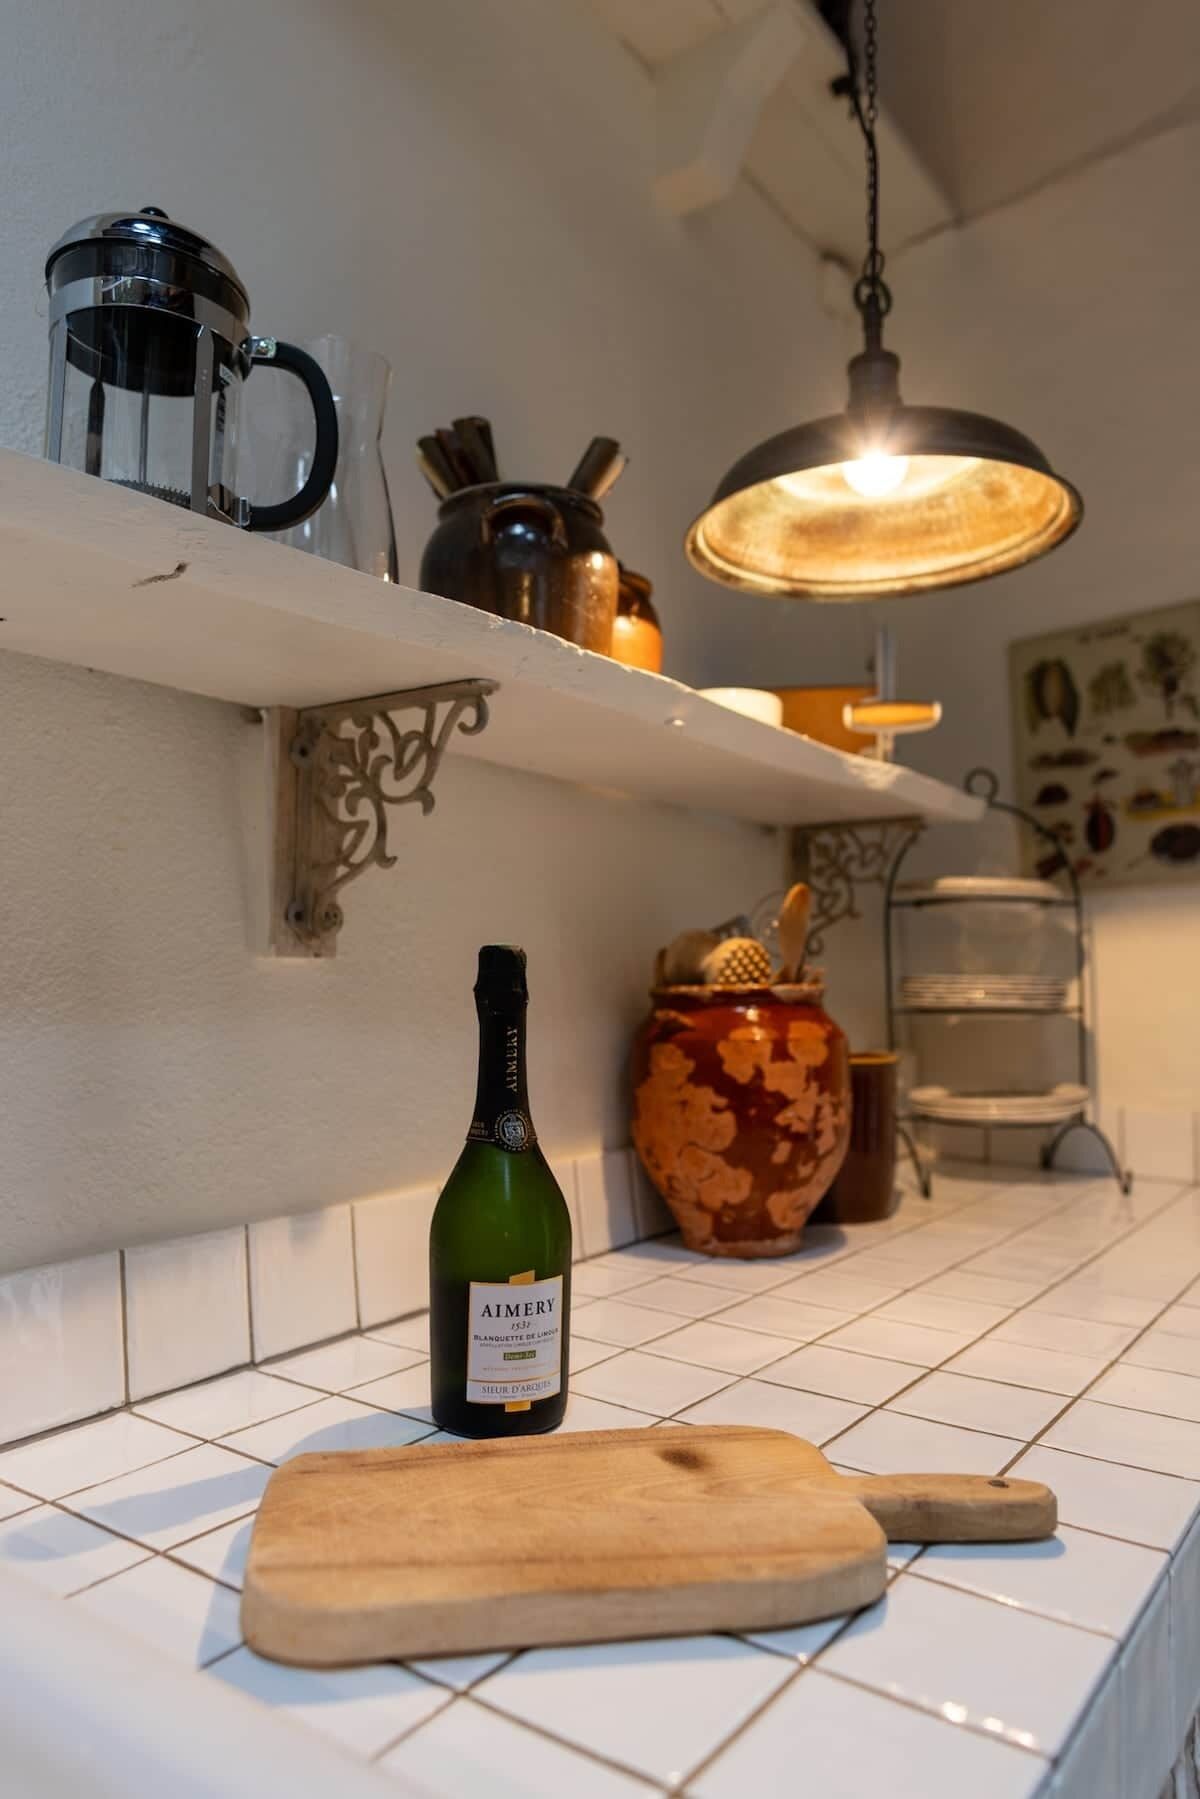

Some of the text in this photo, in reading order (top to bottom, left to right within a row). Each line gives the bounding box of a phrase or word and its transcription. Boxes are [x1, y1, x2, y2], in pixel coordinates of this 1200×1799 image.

[505, 1025, 518, 1092] AIMERY
[481, 1298, 554, 1317] AIMERY
[511, 1321, 530, 1331] 1531
[473, 1334, 523, 1342] BLANQUETTE
[481, 1380, 551, 1394] SIEUR D'ARQUES
